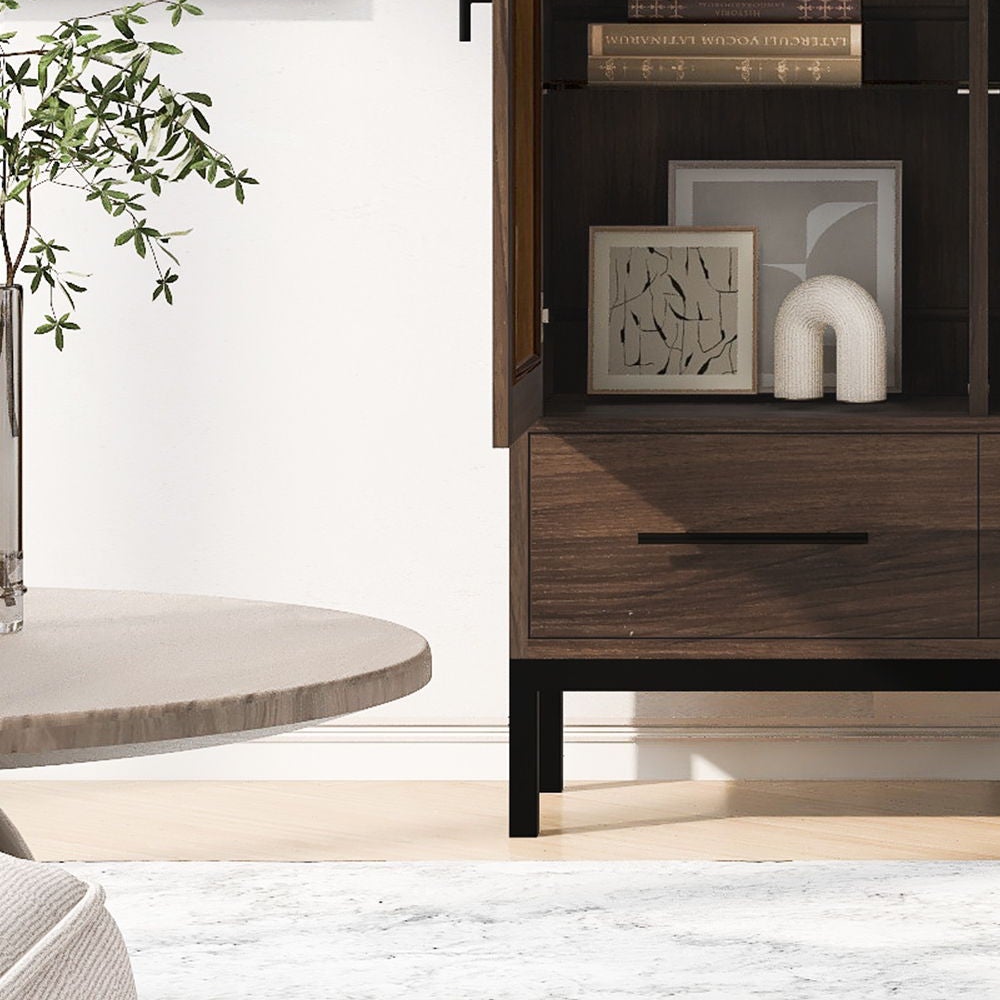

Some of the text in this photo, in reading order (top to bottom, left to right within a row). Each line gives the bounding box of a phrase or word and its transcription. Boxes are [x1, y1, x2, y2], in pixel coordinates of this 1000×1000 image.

[605, 35, 847, 46] LATERCULI VOCUM LATINARUM
